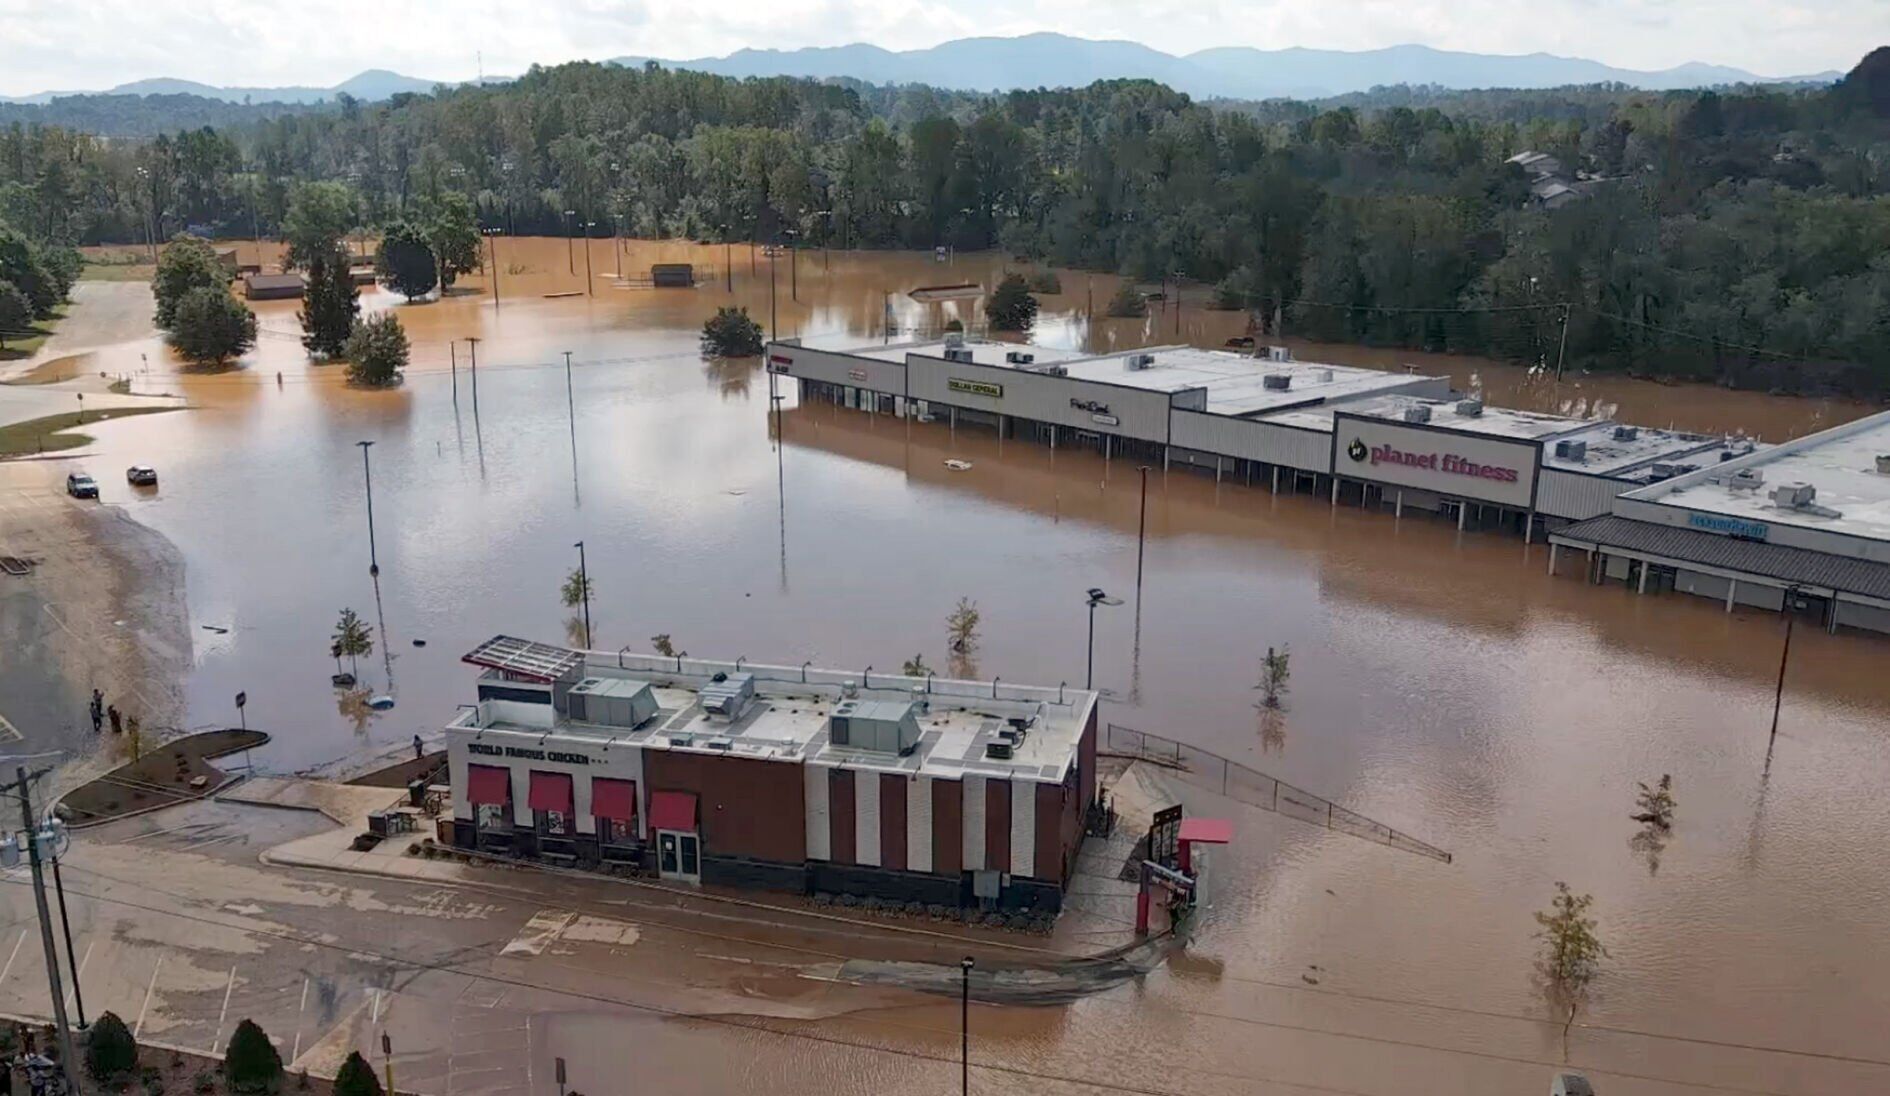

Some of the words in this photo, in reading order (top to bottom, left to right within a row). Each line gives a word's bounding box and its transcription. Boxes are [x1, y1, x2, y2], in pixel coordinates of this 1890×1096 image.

[972, 384, 998, 395] GENERAL
[1370, 444, 1437, 470] planet
[1441, 453, 1518, 482] fitness
[467, 743, 502, 756] WORLD
[505, 746, 545, 760] FAMOUS
[547, 750, 589, 765] CHICKEN
